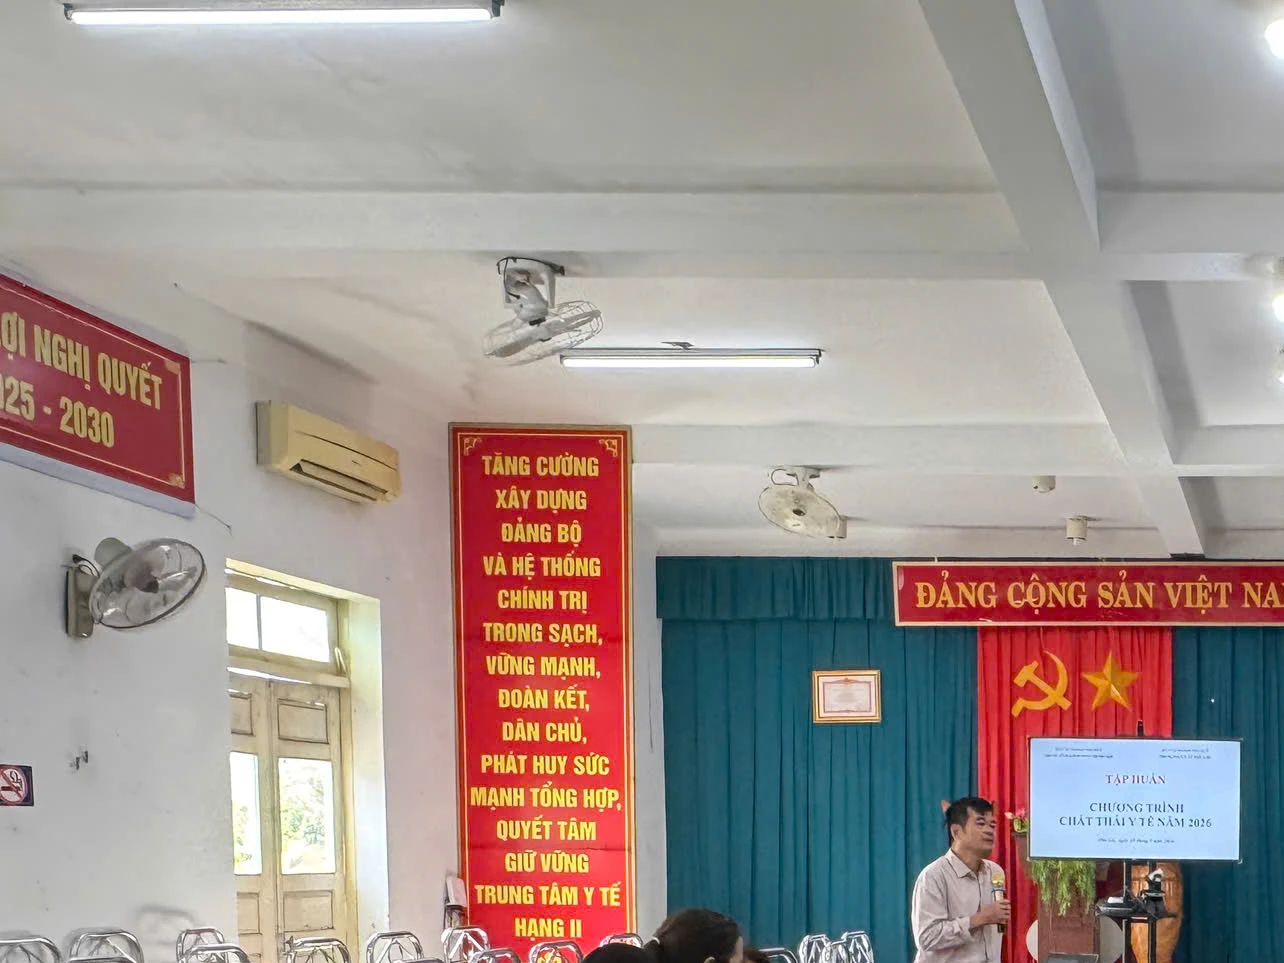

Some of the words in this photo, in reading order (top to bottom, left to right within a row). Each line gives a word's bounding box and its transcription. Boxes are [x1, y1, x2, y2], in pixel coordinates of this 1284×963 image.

[0, 311, 26, 360] ỢI
[33, 324, 91, 391] NGHỊ
[98, 352, 162, 411] QUYẾT
[43, 405, 52, 416] -
[60, 396, 115, 448] 2030
[482, 452, 530, 476] TĂNG
[536, 452, 599, 477] CƯỜNG
[496, 485, 531, 509] XÂY
[536, 488, 587, 514] DỰNG
[501, 516, 552, 543] ĐẢNG
[557, 520, 582, 548] BỘ
[483, 552, 507, 575] VÀ
[512, 552, 535, 580] HỆ
[541, 550, 601, 577] THỐNG
[498, 586, 554, 610] CHÍNH
[559, 591, 588, 614] TRỊ
[914, 570, 998, 609] ĐẢNG
[1006, 572, 1087, 615] CỘNG
[1098, 570, 1156, 609] SẢN
[1162, 574, 1233, 615] VIỆT
[483, 623, 543, 643] TRONG
[549, 624, 603, 647] SẠCH,
[486, 652, 535, 676] VỮNG
[541, 656, 601, 680] MẠNH,
[498, 686, 548, 709] ĐOÀN
[554, 684, 590, 711] KẾT,
[502, 719, 540, 742] DÂN
[546, 716, 587, 744] CHỦ,
[480, 752, 528, 774] PHÁT
[533, 756, 568, 775] HUY
[574, 752, 610, 776] SỨC
[470, 787, 524, 811] MẠNH
[530, 780, 578, 808] TỔNG
[583, 788, 622, 812] HỢP,
[496, 814, 552, 842] QUYẾT
[558, 818, 596, 841] TÂM
[1128, 817, 1137, 826] Y
[1188, 818, 1213, 828] 2026
[505, 850, 537, 873] GIỮ
[541, 850, 590, 873] VỮNG
[474, 885, 534, 905] TRUNG
[539, 882, 578, 906] TÂM
[584, 886, 594, 906] Y
[599, 881, 622, 907] TẾ
[515, 918, 564, 943] HẠNG
[570, 919, 582, 938] II
